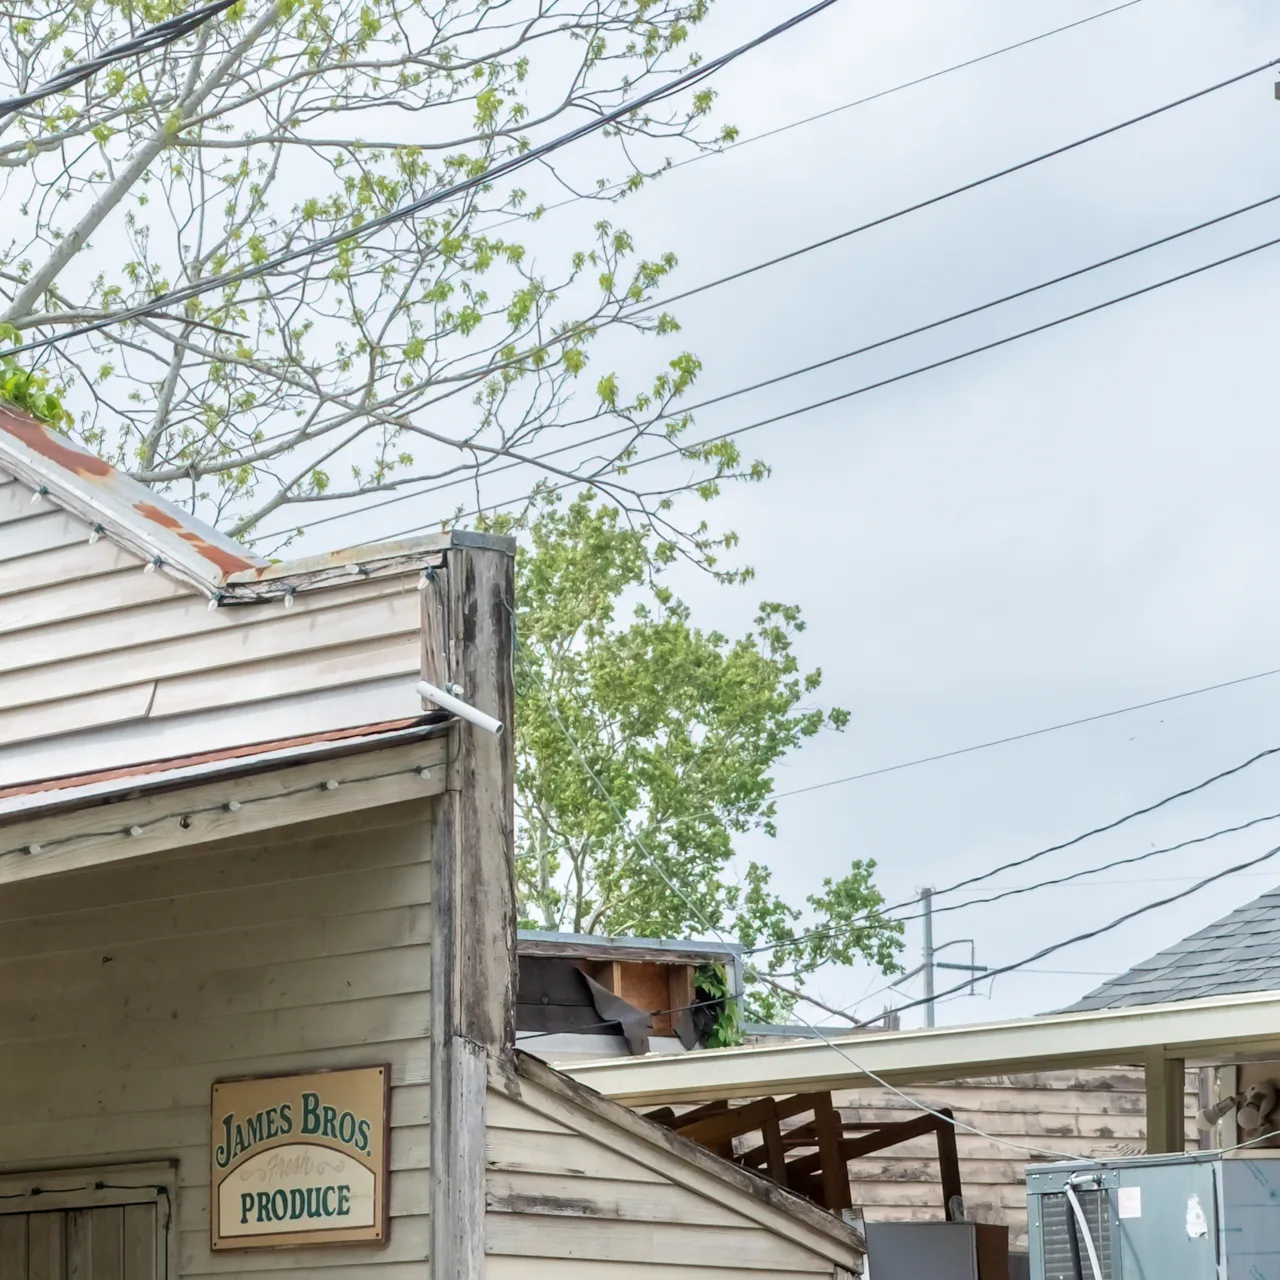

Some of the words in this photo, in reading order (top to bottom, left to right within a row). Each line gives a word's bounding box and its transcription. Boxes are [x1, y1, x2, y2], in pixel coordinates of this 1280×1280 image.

[215, 1103, 293, 1168] JAMES
[266, 1150, 314, 1184] Fresh
[240, 1184, 351, 1224] PRODUCE
